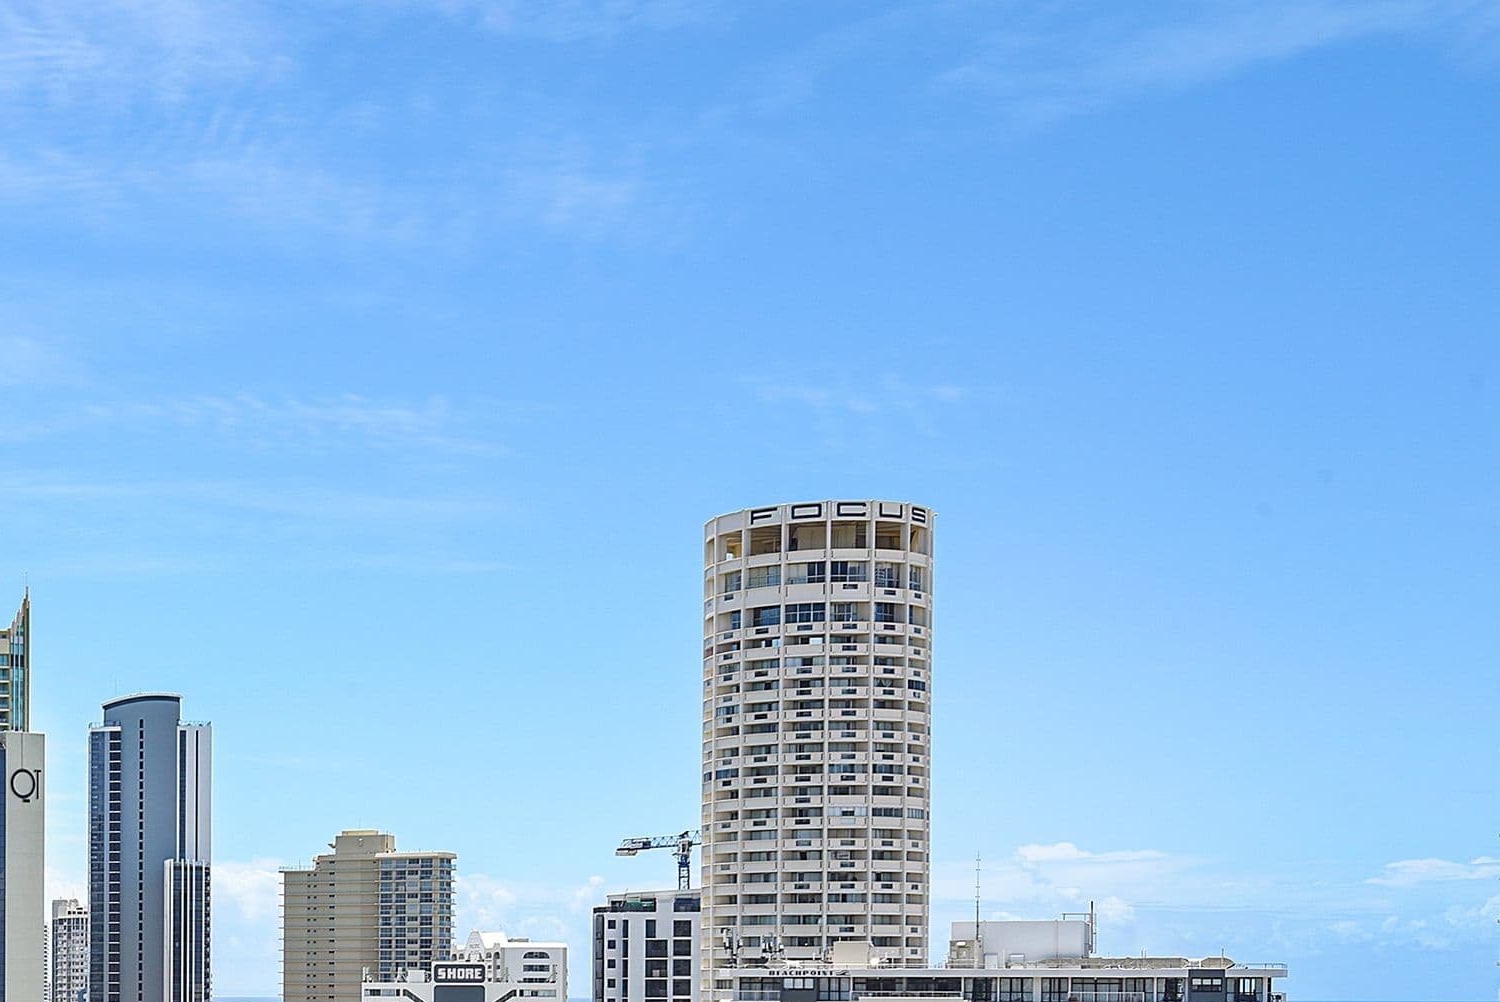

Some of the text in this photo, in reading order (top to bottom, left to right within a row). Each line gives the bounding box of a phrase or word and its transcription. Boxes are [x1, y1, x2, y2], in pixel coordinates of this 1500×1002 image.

[751, 502, 926, 525] FOCUS
[11, 769, 41, 803] QT
[437, 968, 483, 979] SHORE
